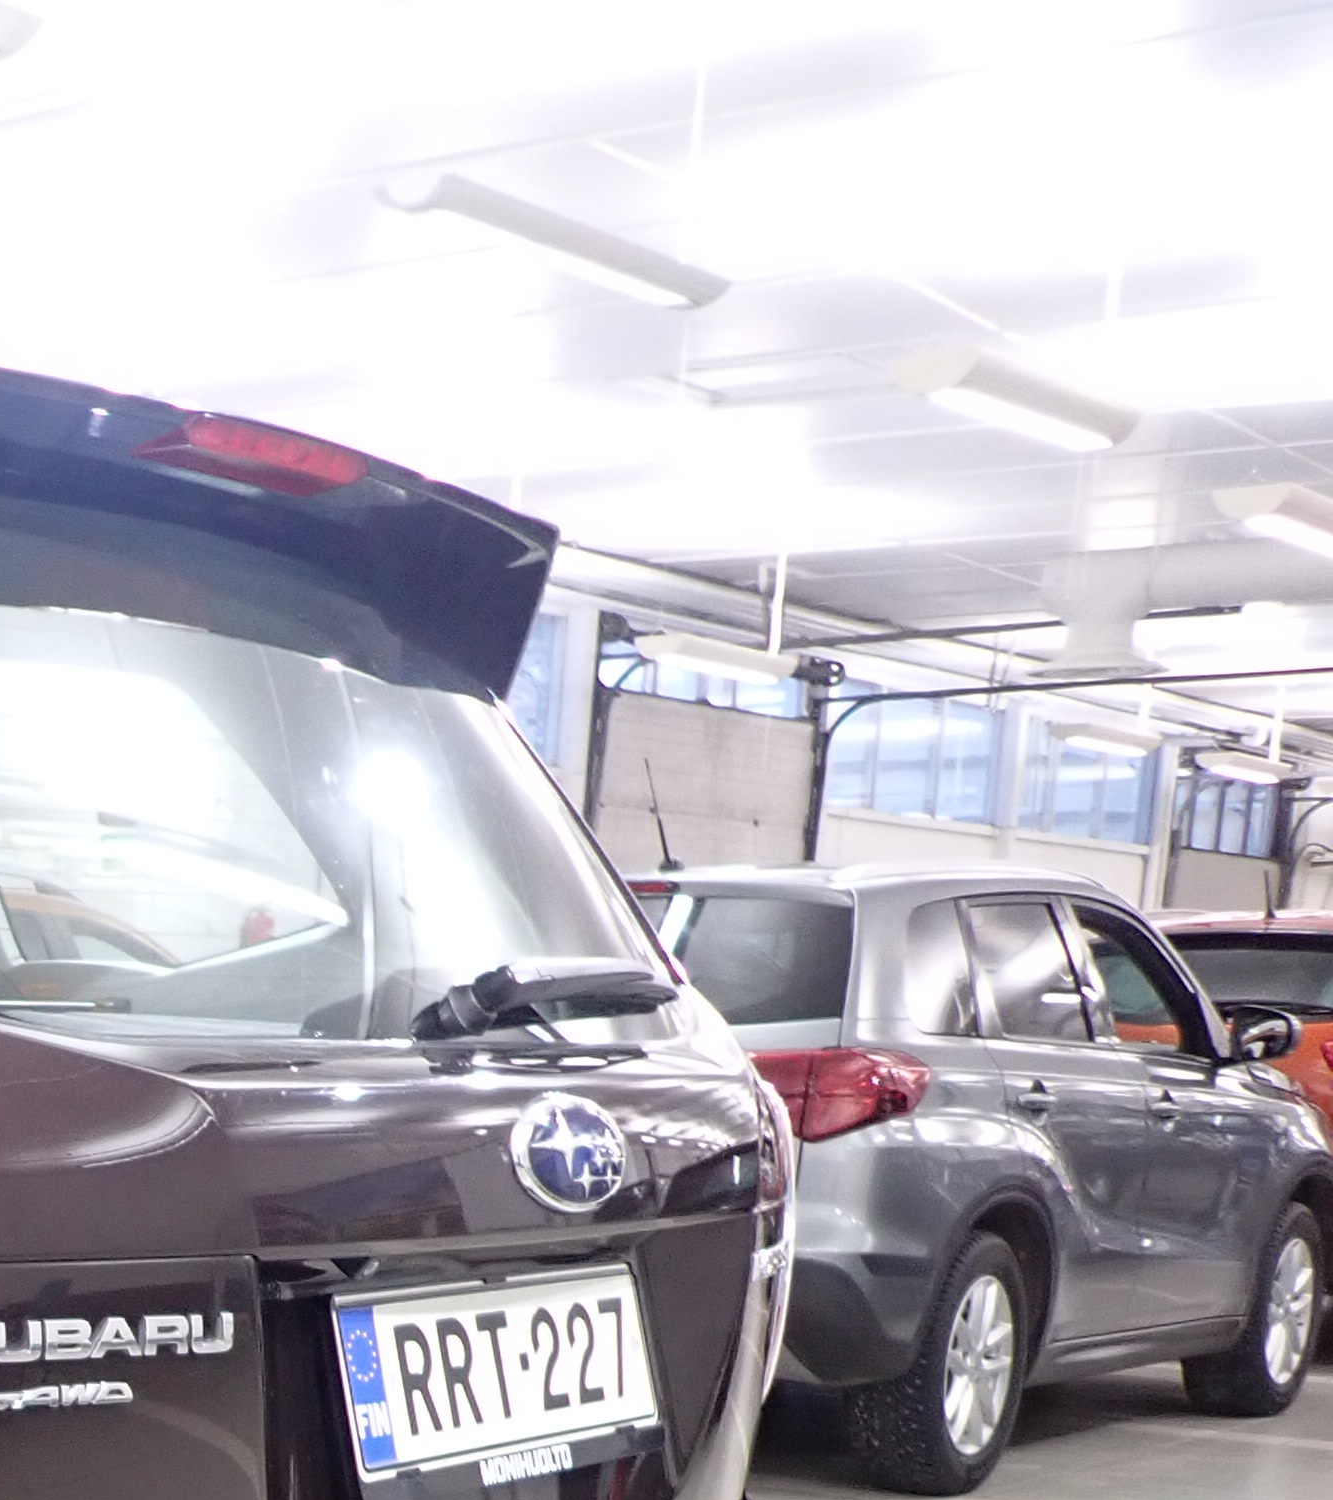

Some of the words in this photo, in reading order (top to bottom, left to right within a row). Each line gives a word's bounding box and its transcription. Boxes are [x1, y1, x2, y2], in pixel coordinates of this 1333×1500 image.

[393, 1297, 624, 1437] RRT-227
[12, 1381, 134, 1410] AWD
[355, 1402, 391, 1440] FIN
[480, 1443, 573, 1487] MONIHUOLTO
